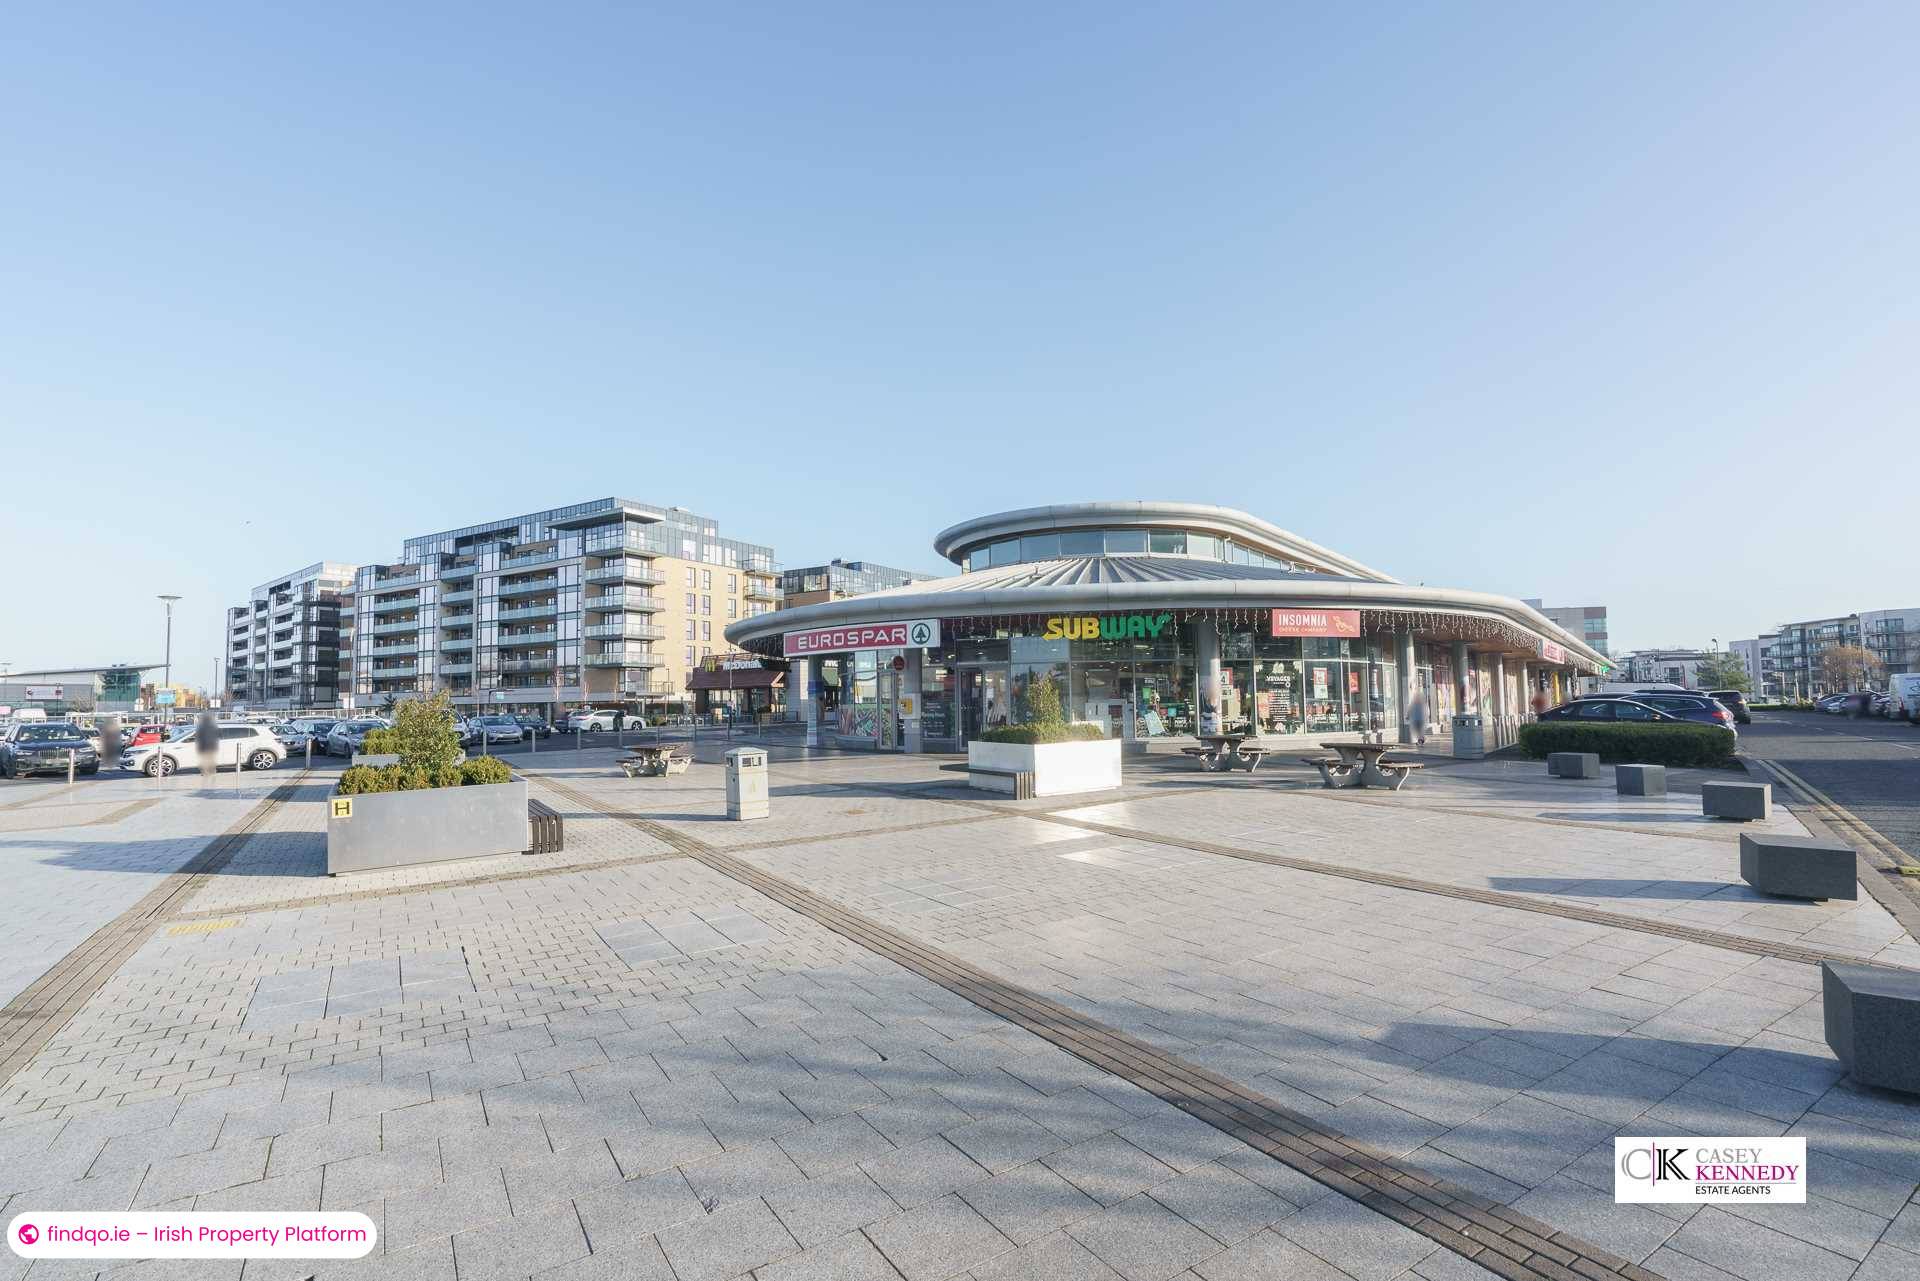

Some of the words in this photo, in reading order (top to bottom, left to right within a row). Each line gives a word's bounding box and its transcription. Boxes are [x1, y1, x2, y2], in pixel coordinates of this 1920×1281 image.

[1042, 612, 1172, 640] SUBWAY
[1279, 614, 1327, 626] INSOMNIA
[797, 628, 906, 649] EUROSPAR
[335, 801, 350, 816] H
